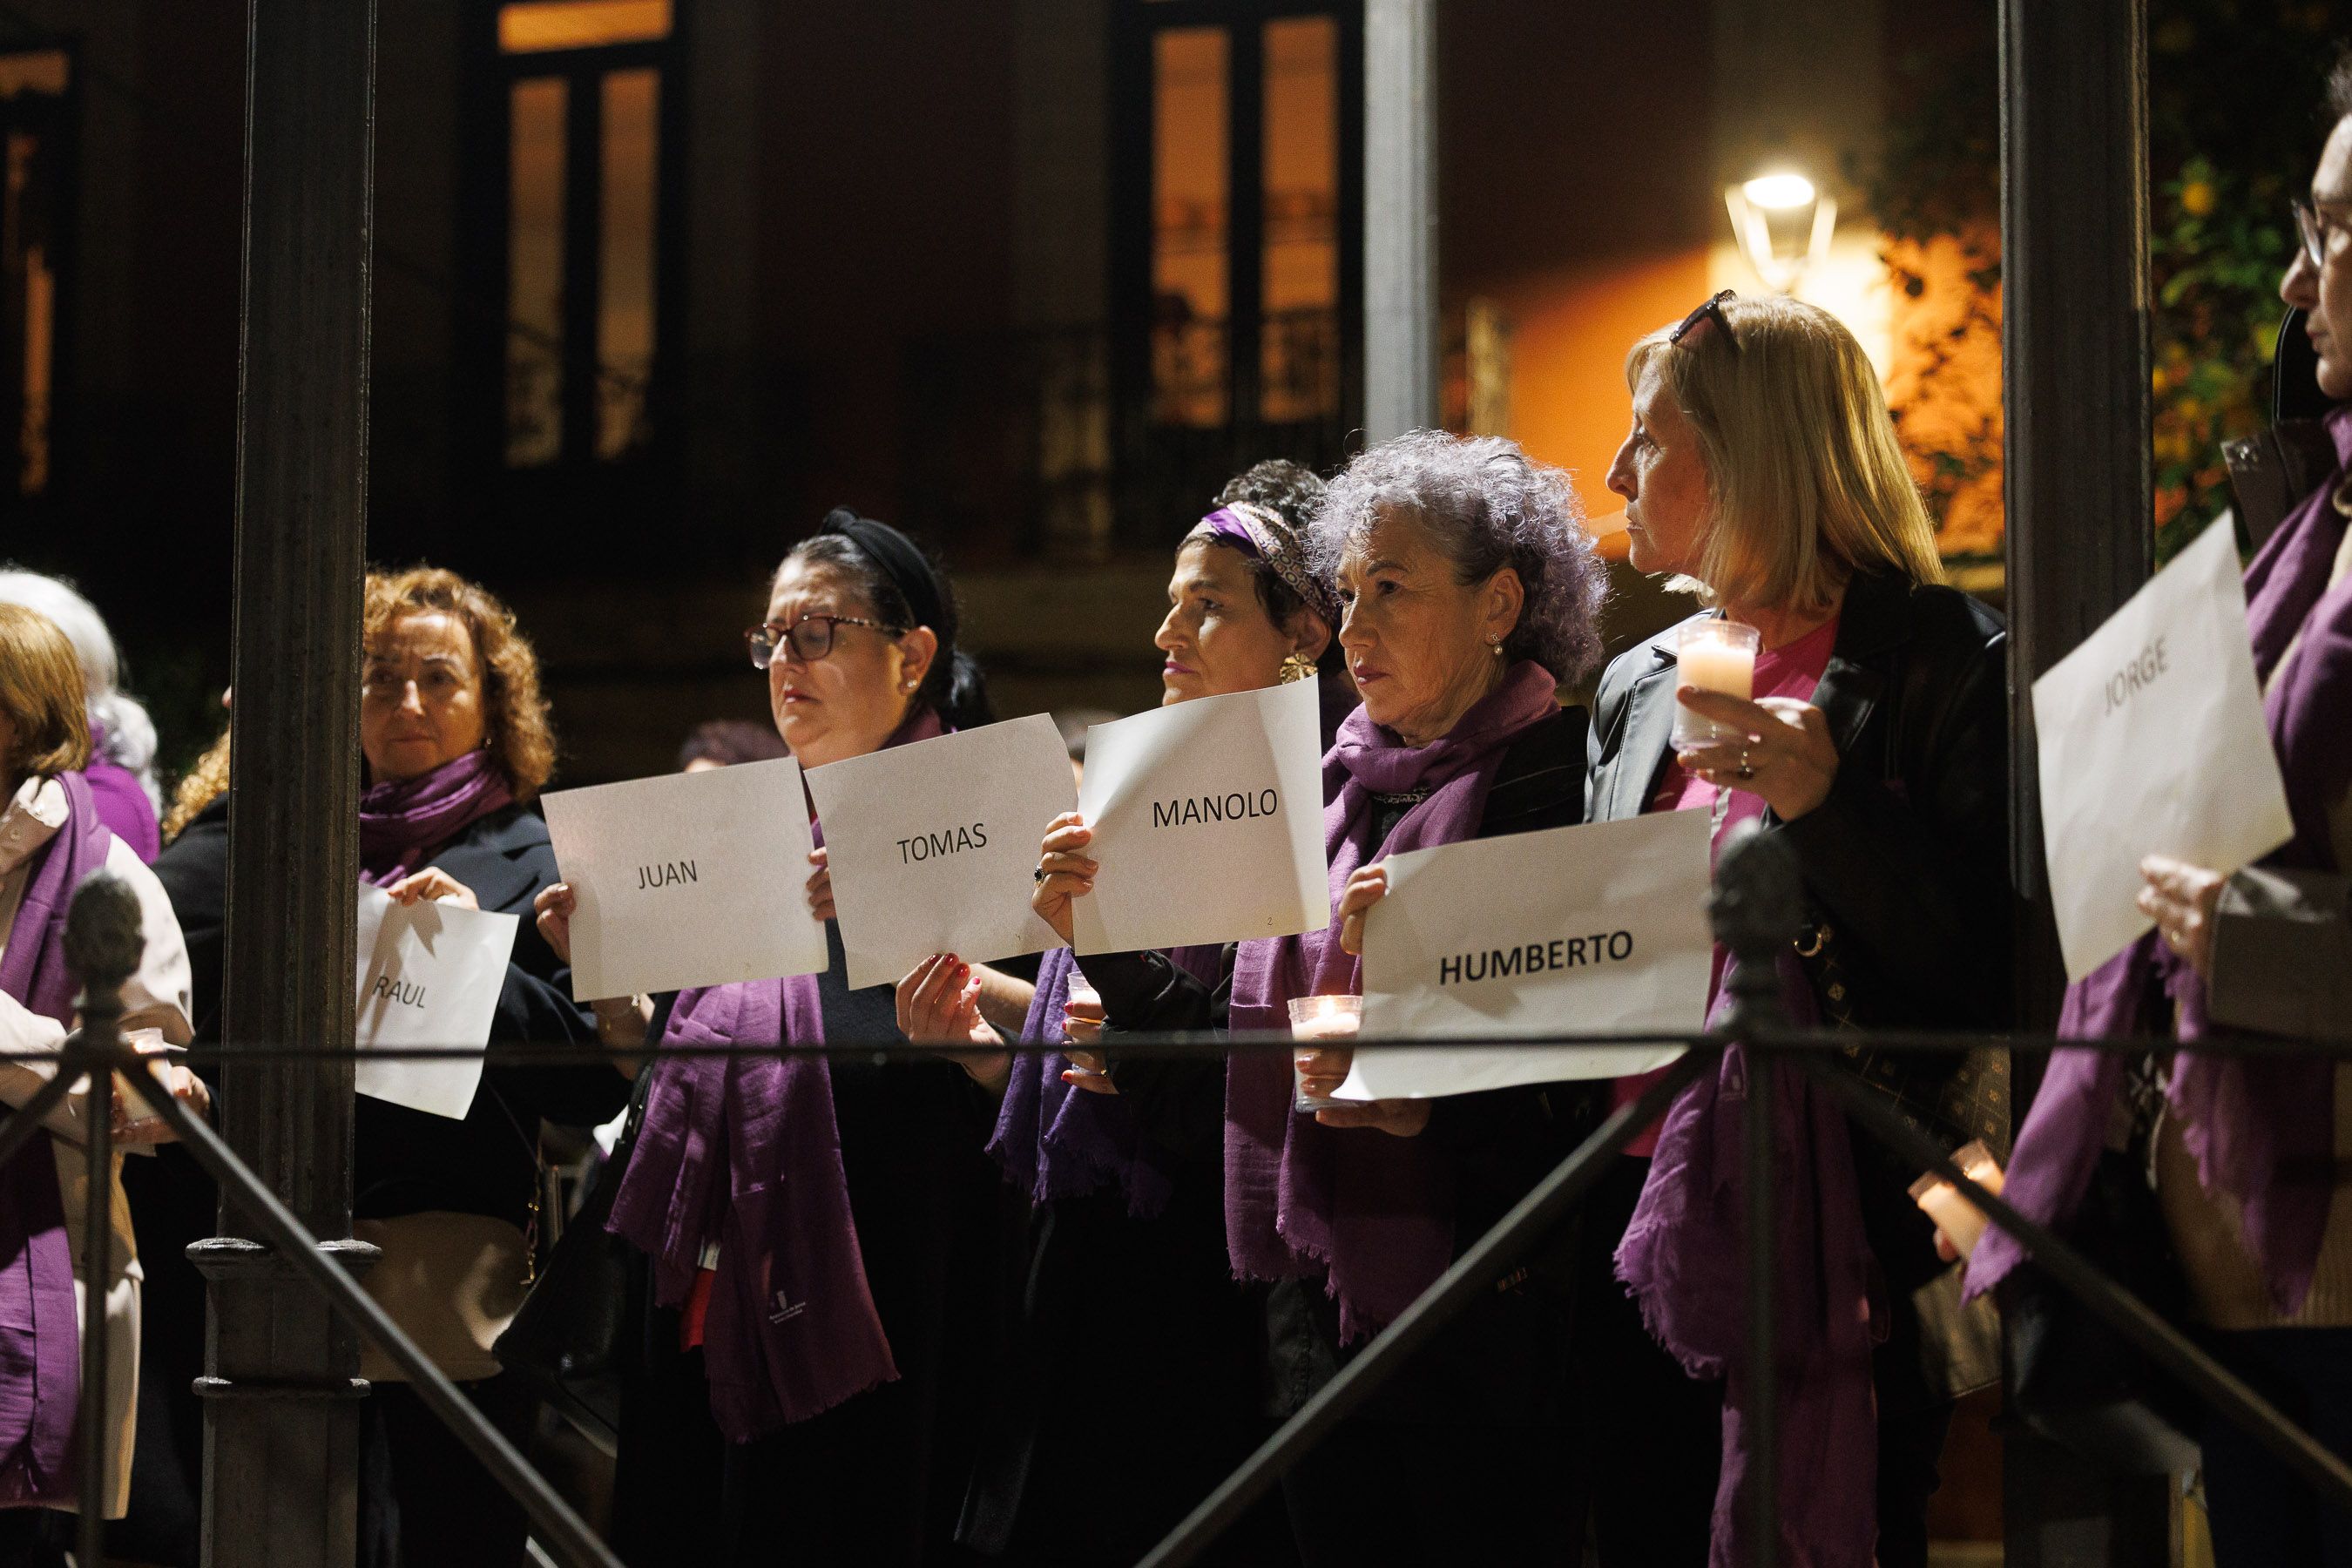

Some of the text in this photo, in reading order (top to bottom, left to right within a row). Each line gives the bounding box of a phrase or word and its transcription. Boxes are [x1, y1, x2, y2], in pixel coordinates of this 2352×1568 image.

[2105, 635, 2168, 716] JORGE
[1152, 787, 1280, 828] MANOLO
[896, 822, 988, 865] TOMAS
[638, 860, 699, 890] JUAN
[1439, 929, 1634, 987] HUMBERTO
[372, 976, 426, 1009] RAUL
